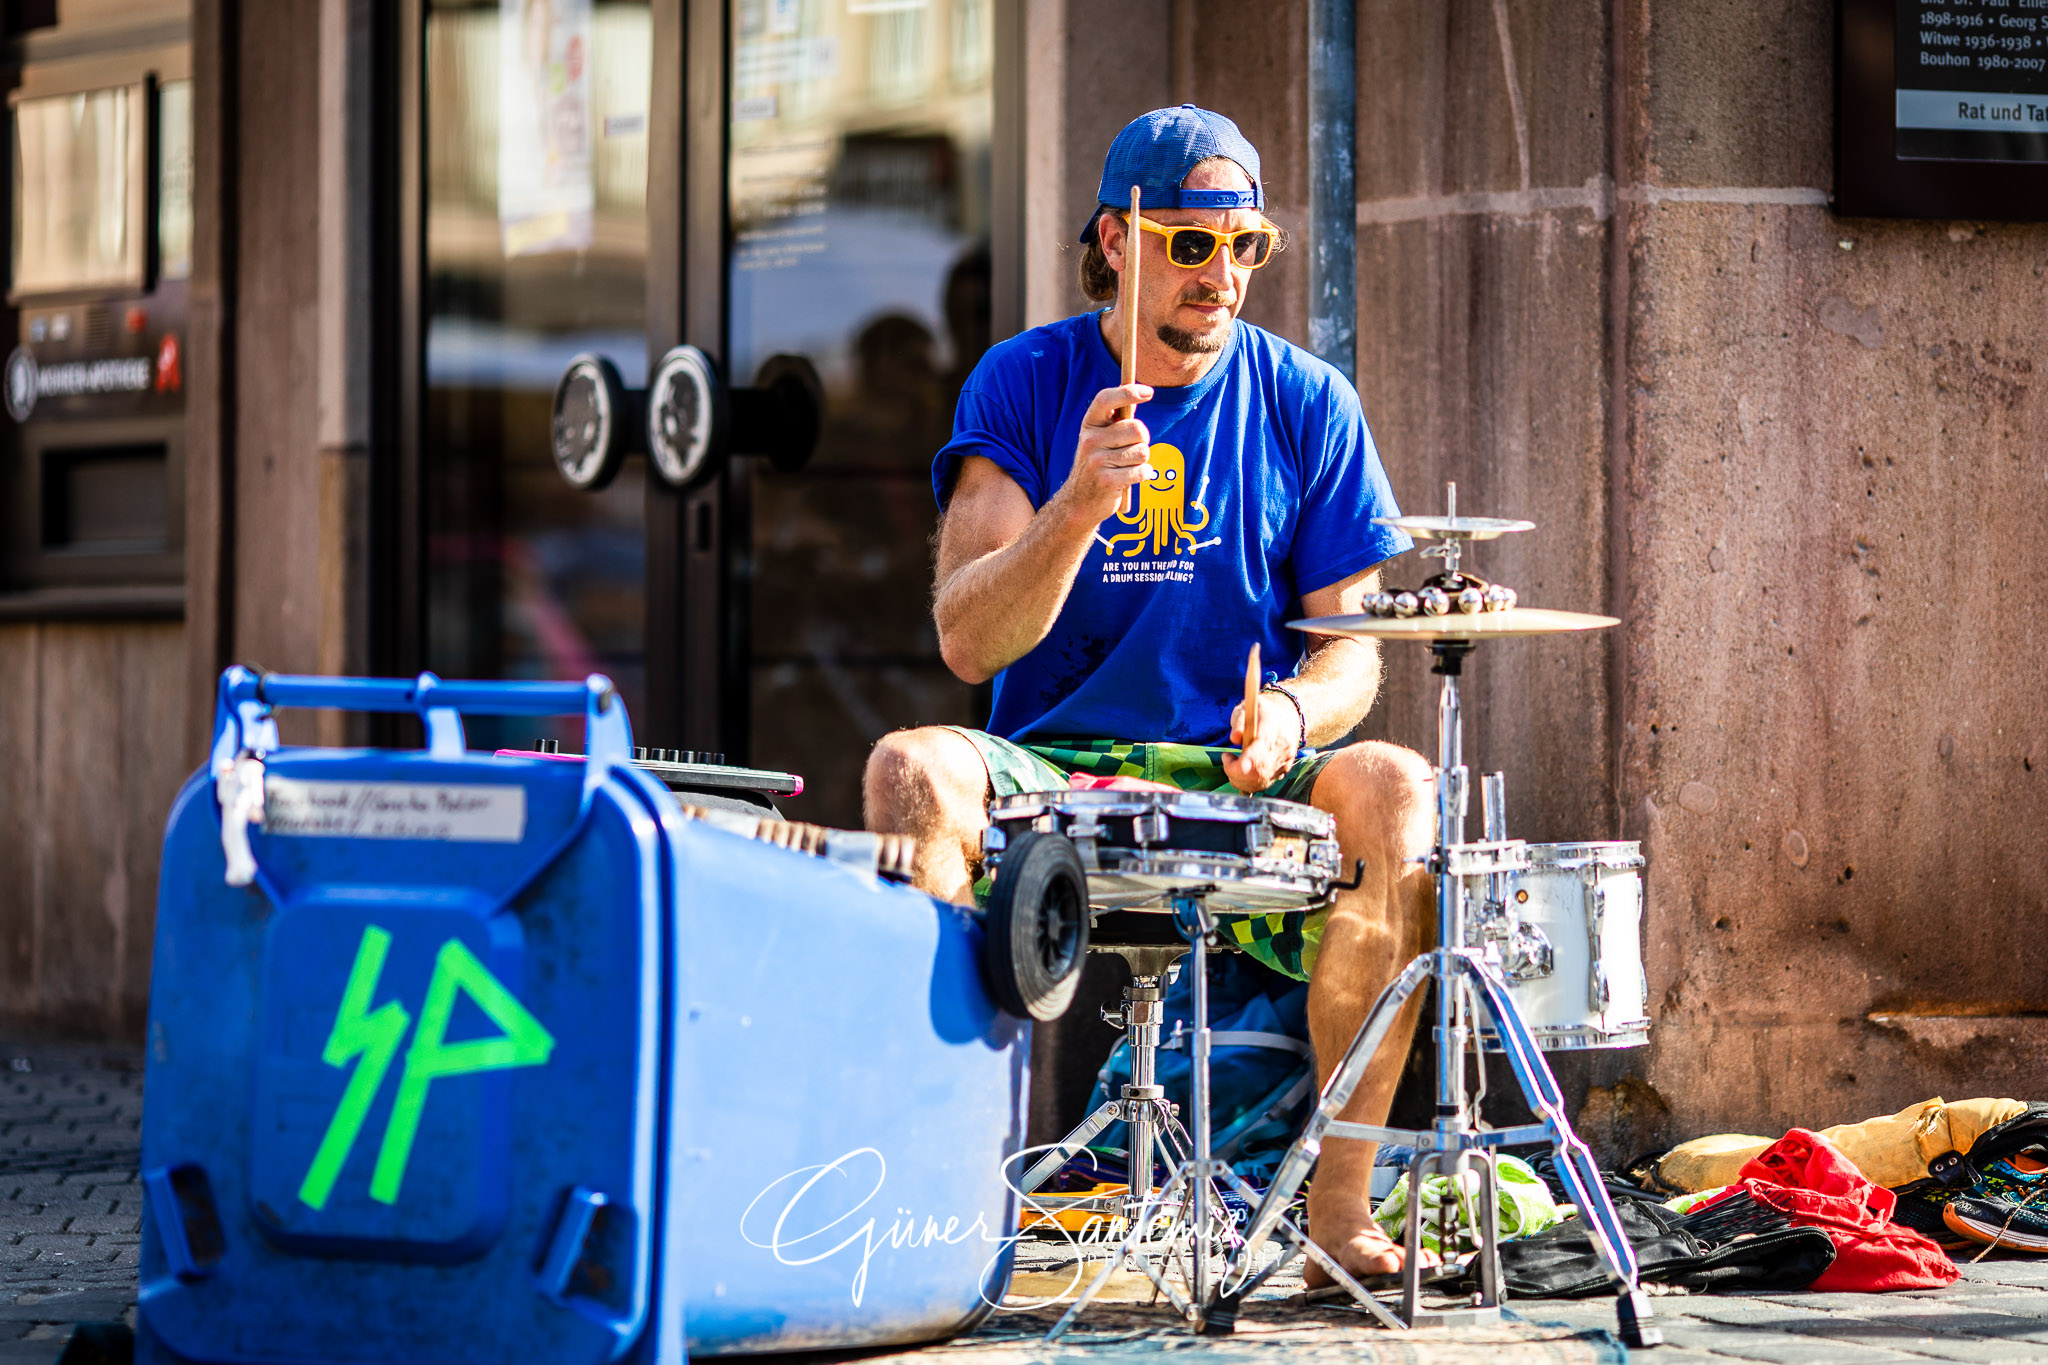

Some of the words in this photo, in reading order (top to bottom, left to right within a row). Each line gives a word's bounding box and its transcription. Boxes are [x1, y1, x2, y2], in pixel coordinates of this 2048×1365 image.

[1920, 11, 1983, 28] 1898-1916
[1999, 13, 2037, 32] Georg
[1920, 31, 1960, 46] Witwe
[1965, 33, 2031, 51] 1936-1938
[1920, 51, 1970, 67] Bouhon
[1978, 54, 2046, 72] 1980-2007
[1958, 102, 1986, 120] Rat
[1991, 103, 2022, 121] und
[1103, 562, 1119, 571] ARE
[1122, 561, 1139, 571] YOU
[1141, 561, 1150, 571] IN
[1179, 560, 1194, 571] FOR
[1103, 574, 1109, 583] A
[1110, 573, 1133, 583] DRUM
